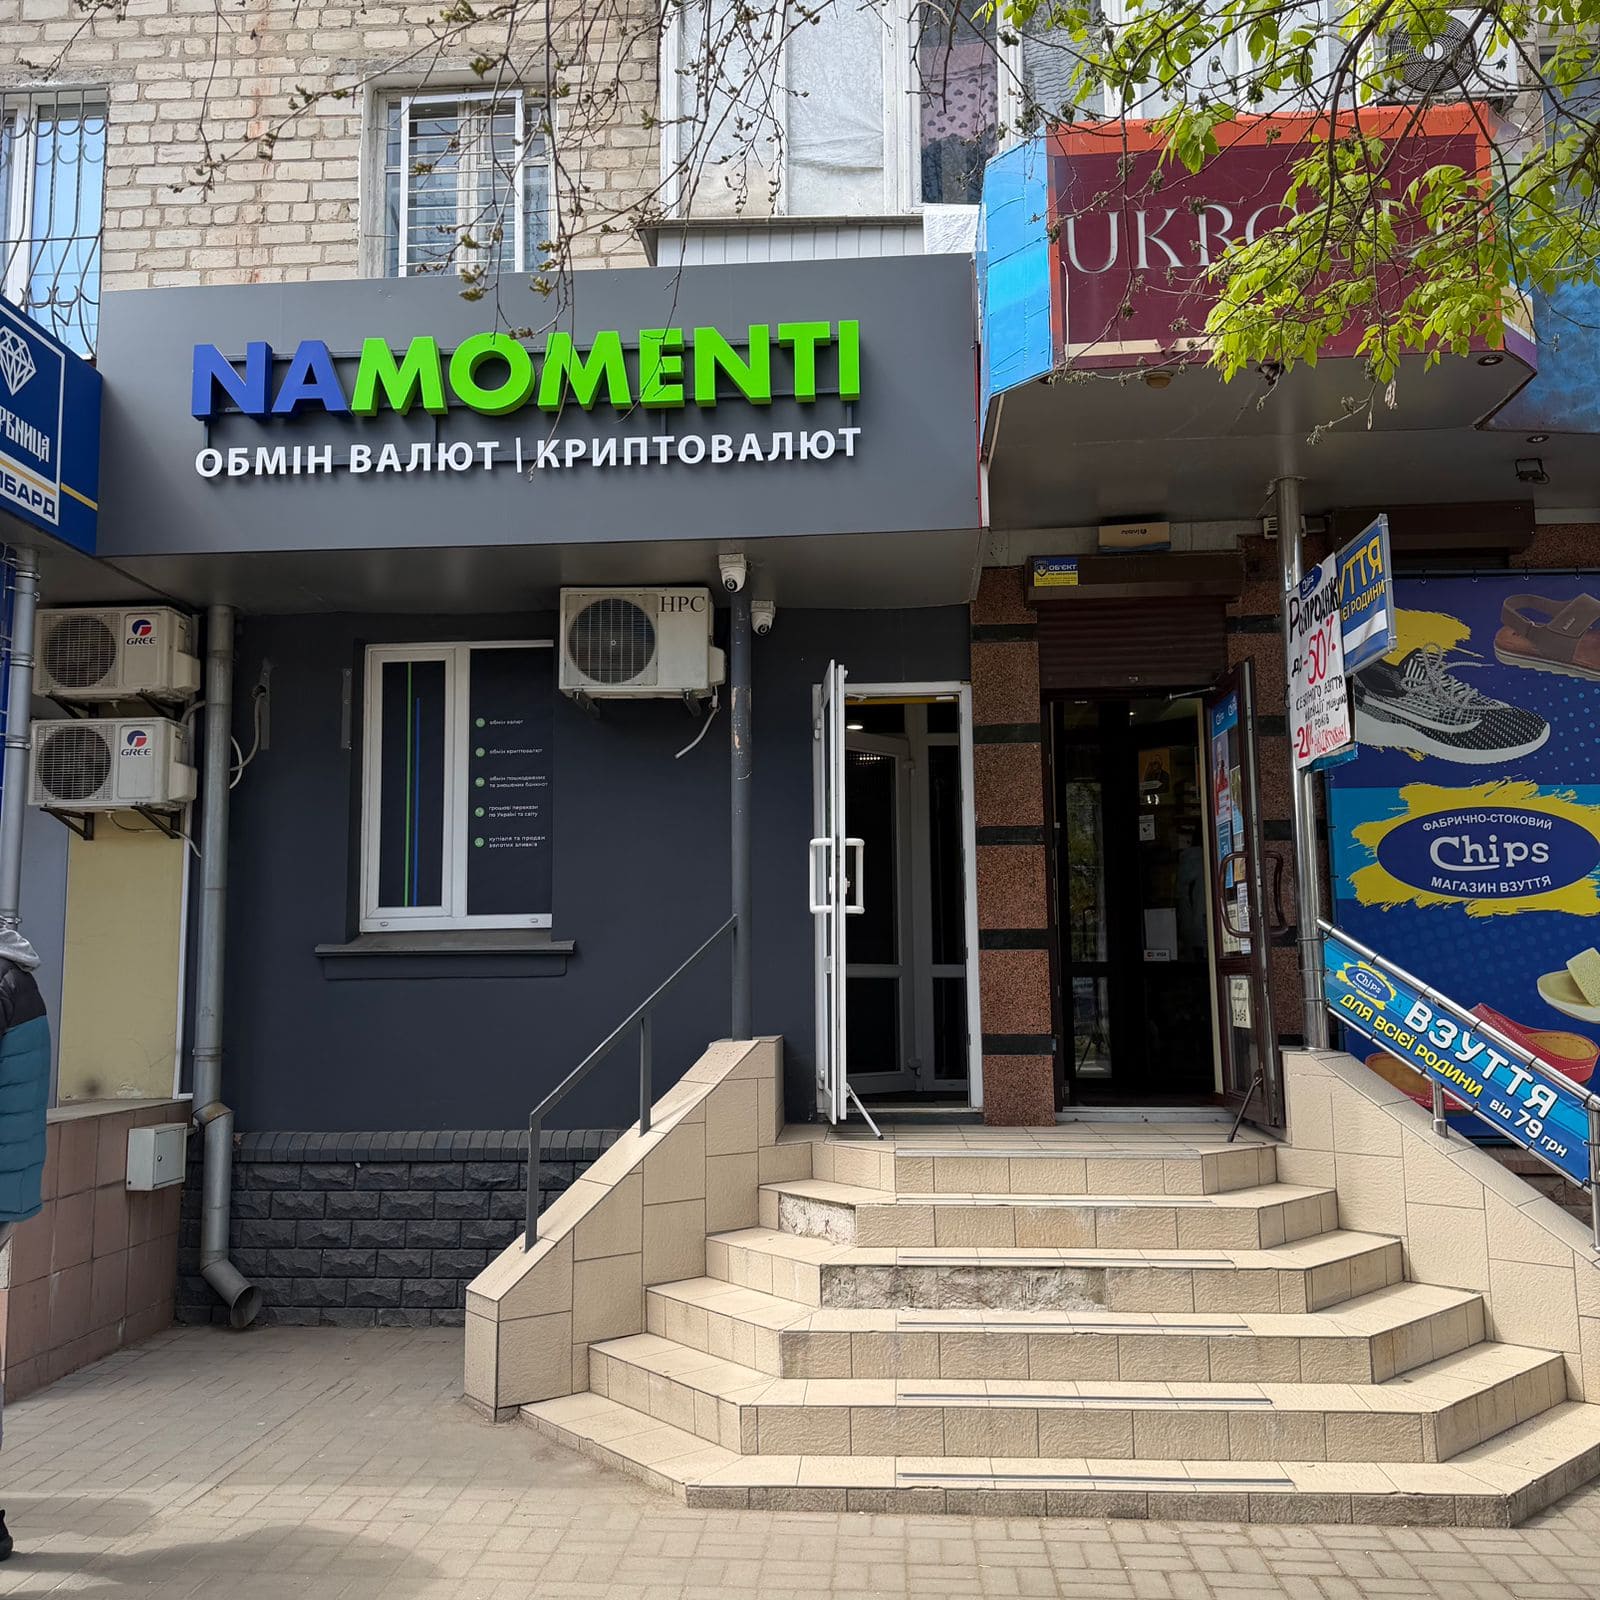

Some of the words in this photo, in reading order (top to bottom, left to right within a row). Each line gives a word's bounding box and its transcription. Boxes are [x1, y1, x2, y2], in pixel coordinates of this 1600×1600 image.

[191, 319, 861, 421] NAMOMENTI
[195, 446, 333, 478] ОБМІН
[350, 441, 500, 474] ВАЛЮТ
[537, 427, 862, 469] КРИПТОВАЛЮТ
[0, 469, 56, 519] БАРД
[660, 596, 706, 613] HPC
[126, 637, 156, 645] GREE
[1303, 614, 1337, 685] -50%
[121, 748, 151, 757] GREE
[1422, 813, 1553, 832] ФАБРИЧНО-СТОКОВИЙ
[1430, 834, 1550, 872] Chips
[1430, 876, 1497, 893] МАГАЗИН
[1500, 875, 1553, 893] ВЗУТТЯ
[1355, 971, 1382, 995] Chips
[1340, 994, 1374, 1022] ДЛЯ
[1373, 1014, 1418, 1050] ВСІЄЇ
[1414, 1044, 1485, 1098] РОДИНИ
[1403, 1001, 1559, 1119] ВЗУТТЯ
[1489, 1098, 1513, 1120] від
[1513, 1113, 1544, 1140] 79
[1540, 1134, 1568, 1158] грн
